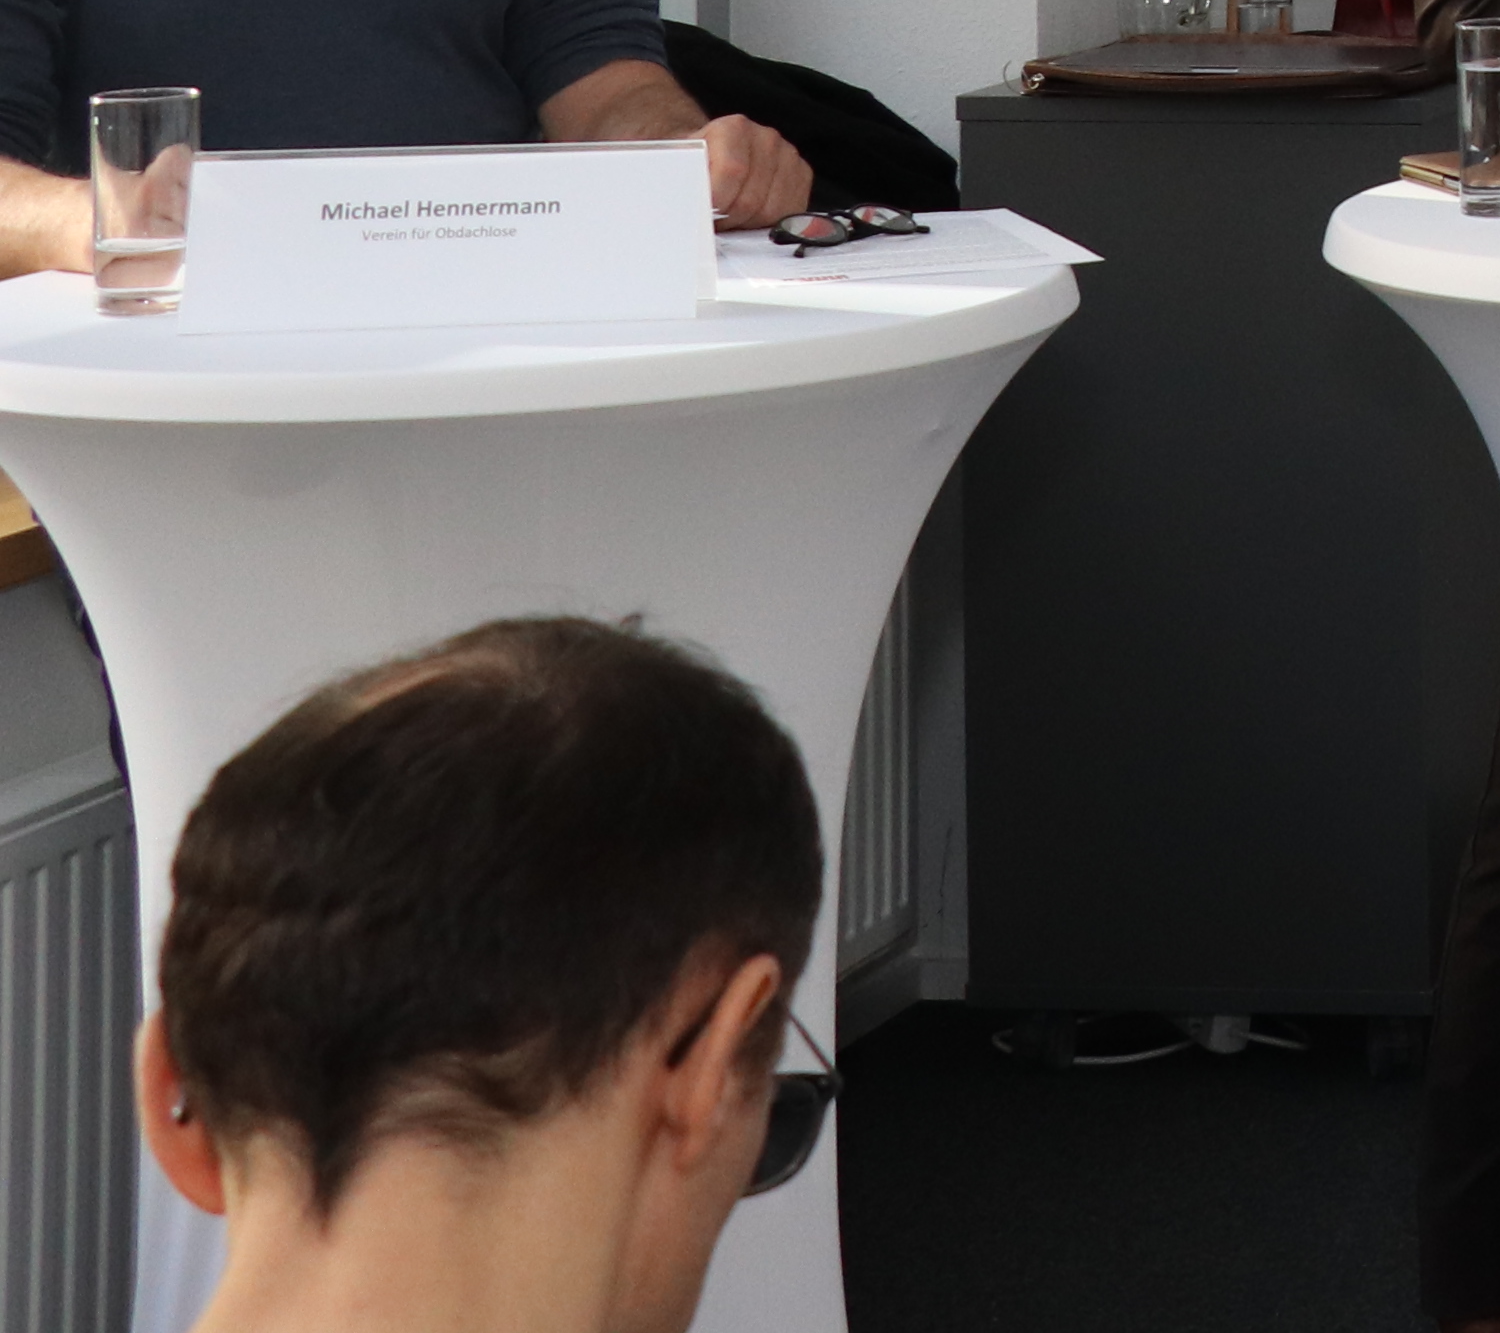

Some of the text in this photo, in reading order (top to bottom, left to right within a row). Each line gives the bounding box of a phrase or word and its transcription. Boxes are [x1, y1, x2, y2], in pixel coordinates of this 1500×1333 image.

[320, 198, 561, 222] Michael Hennermann
[362, 225, 517, 241] Verein für Obdachlose
